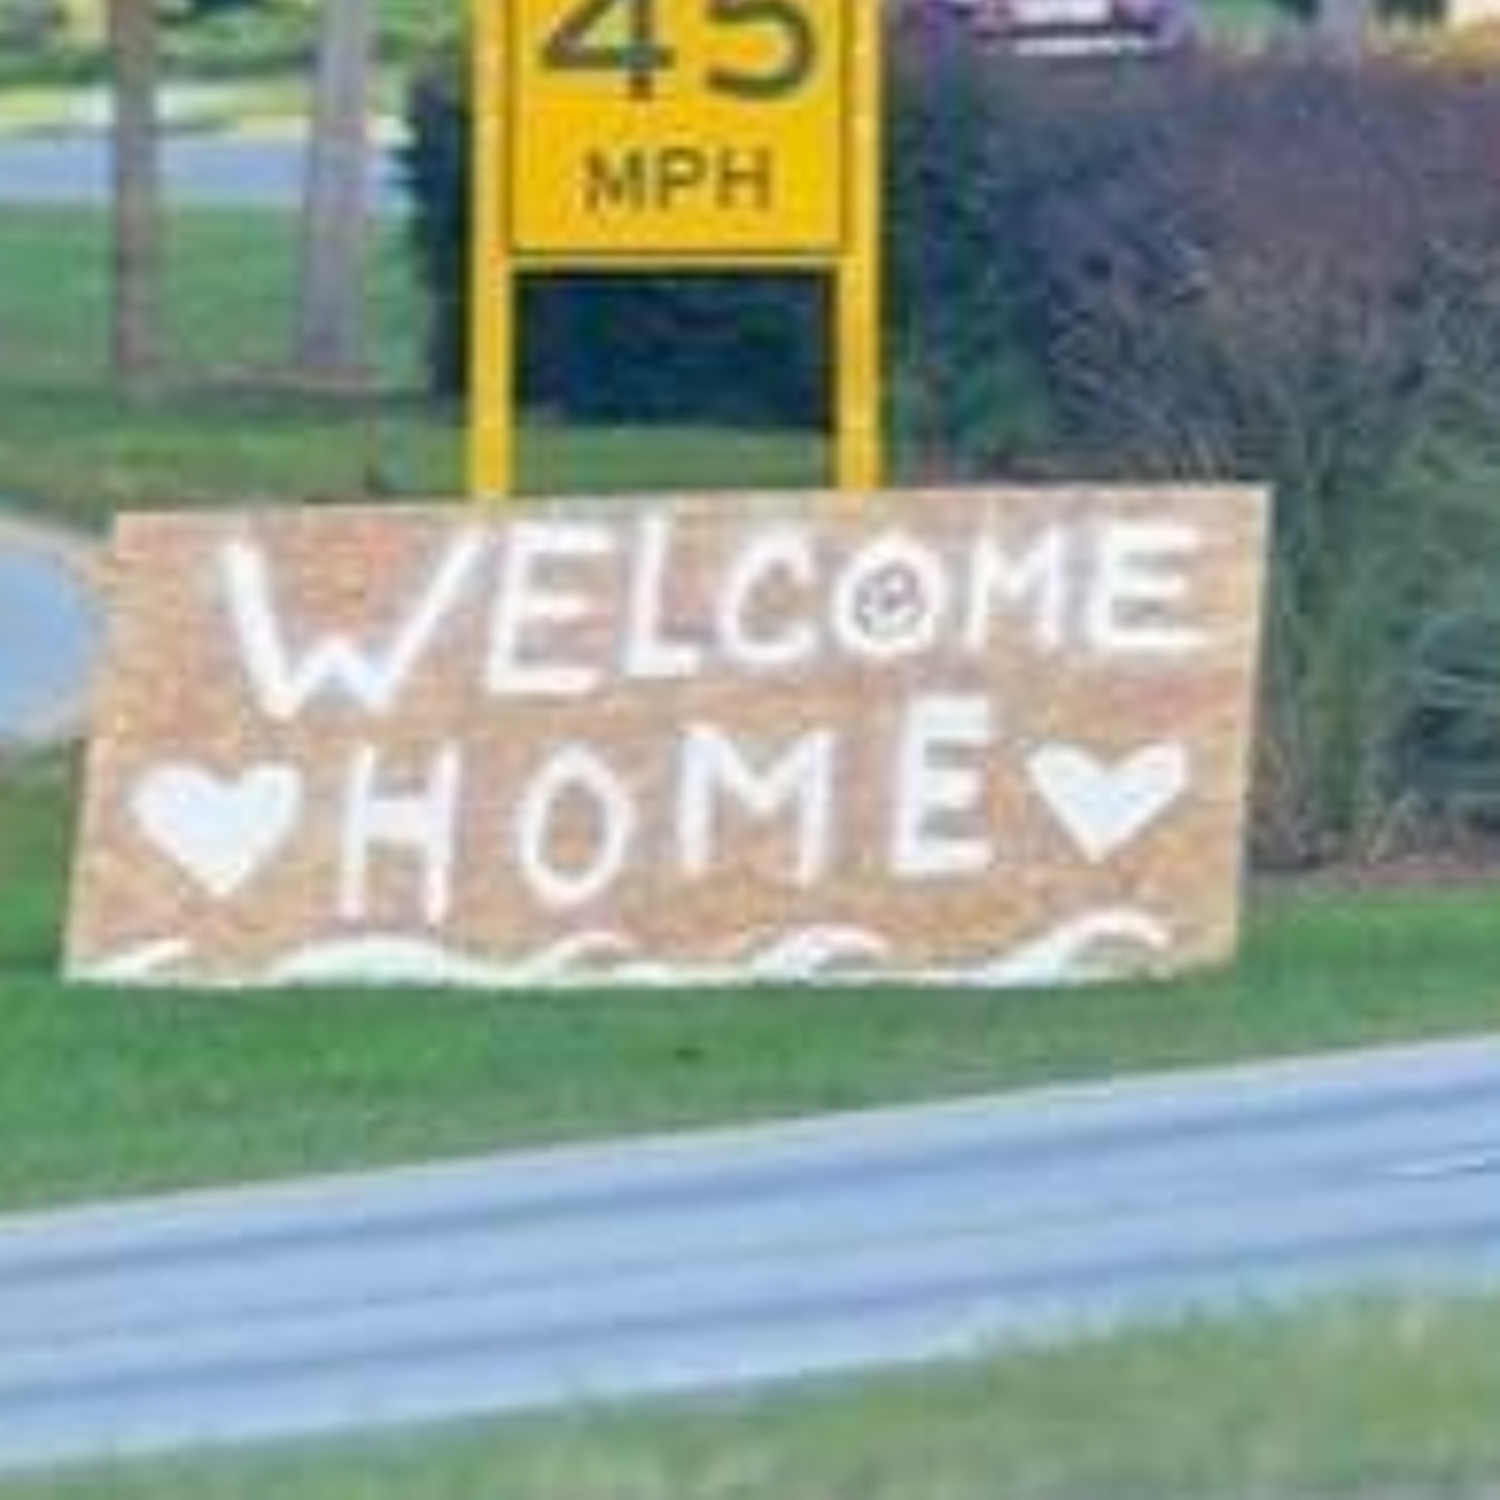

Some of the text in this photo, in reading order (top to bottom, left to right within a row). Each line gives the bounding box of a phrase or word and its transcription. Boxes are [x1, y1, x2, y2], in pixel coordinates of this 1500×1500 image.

[584, 146, 773, 212] MPH
[214, 512, 1214, 718] WELCOME
[341, 693, 998, 924] HOME
